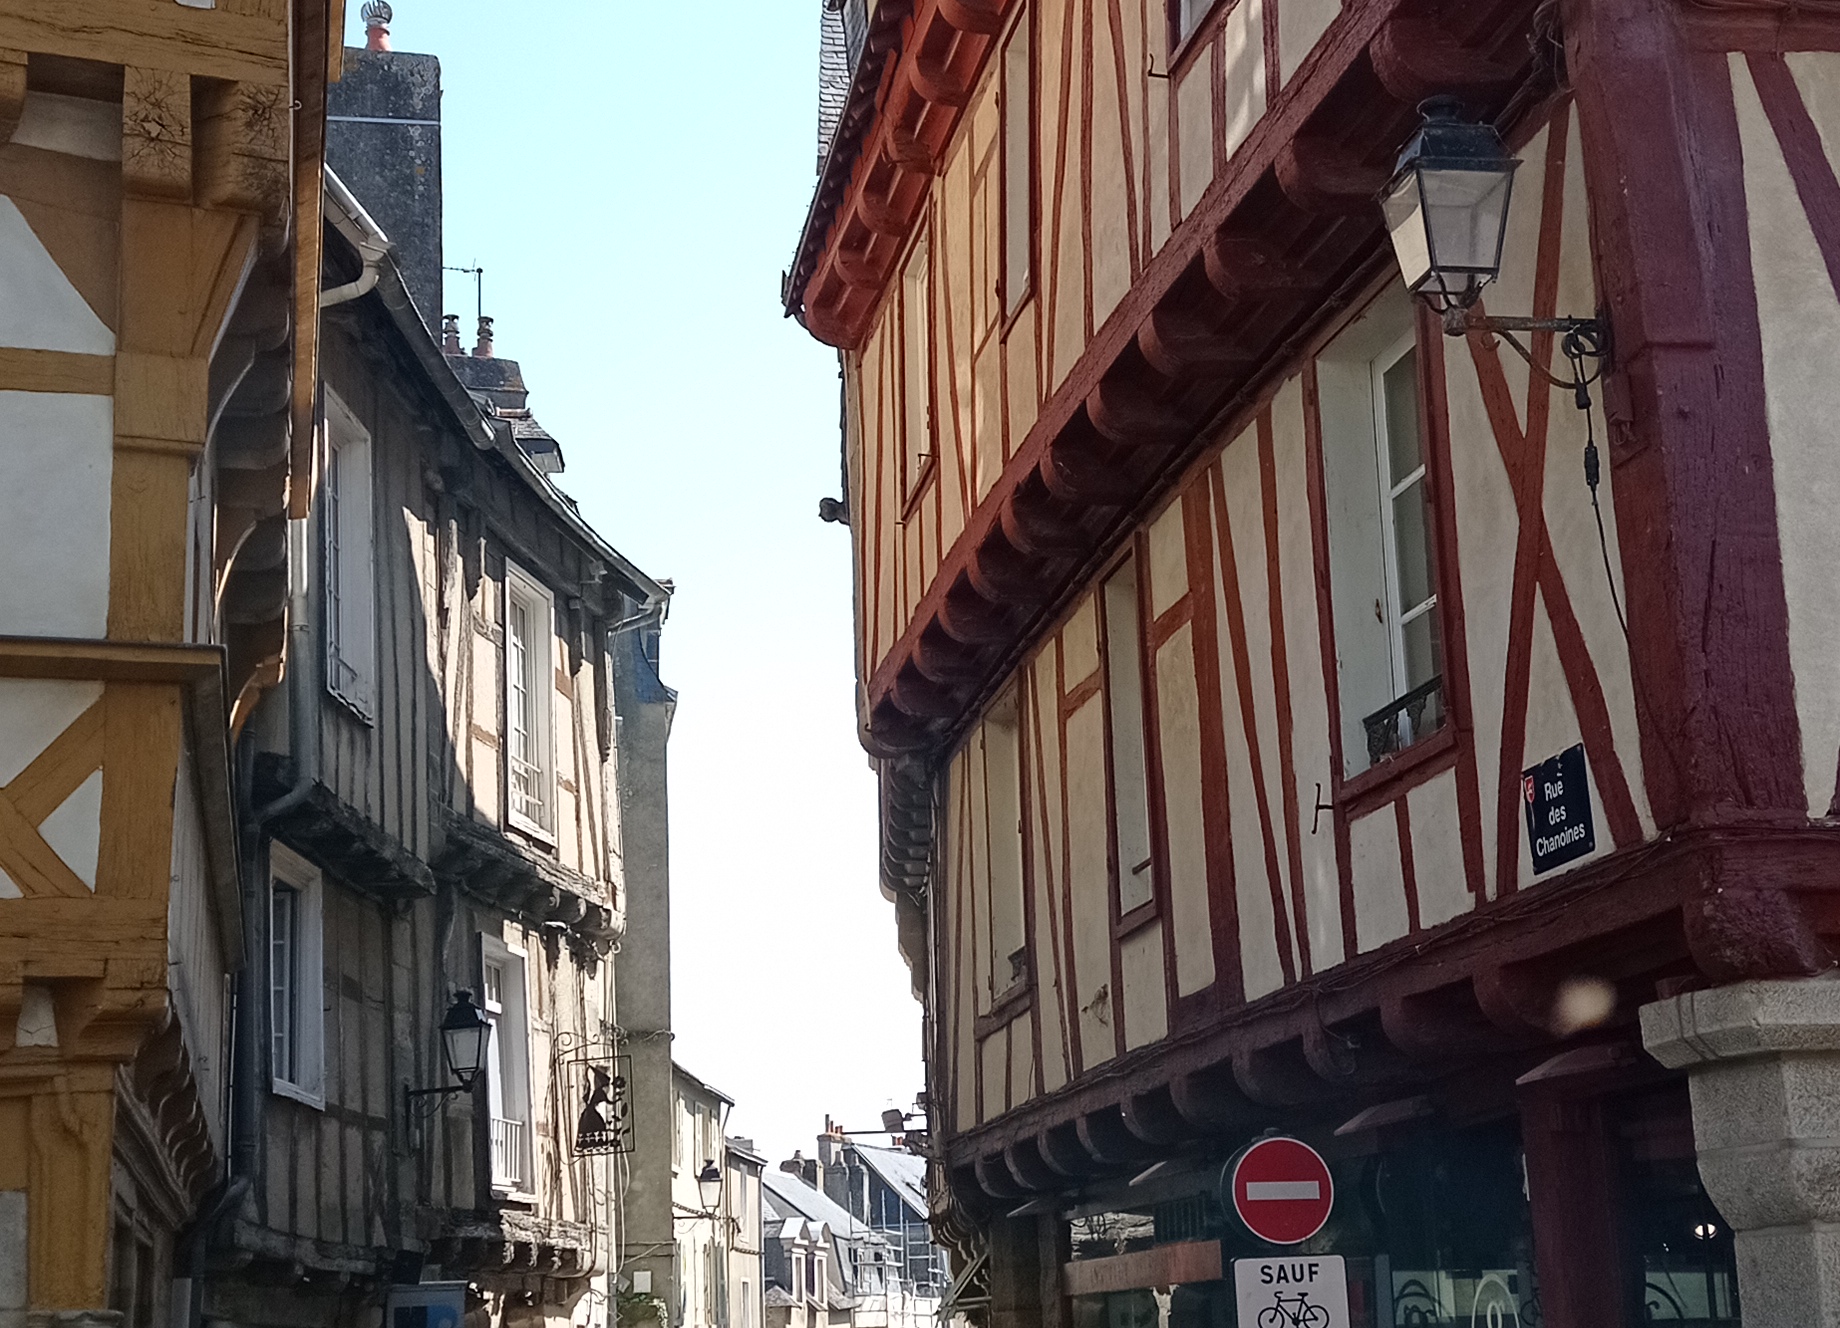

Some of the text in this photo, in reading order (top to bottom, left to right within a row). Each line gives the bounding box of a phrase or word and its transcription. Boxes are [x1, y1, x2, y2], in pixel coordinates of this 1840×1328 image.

[1544, 780, 1563, 801] Rue
[1548, 805, 1566, 825] des
[1536, 823, 1585, 857] Chanoines
[1260, 1263, 1319, 1284] SAUF
